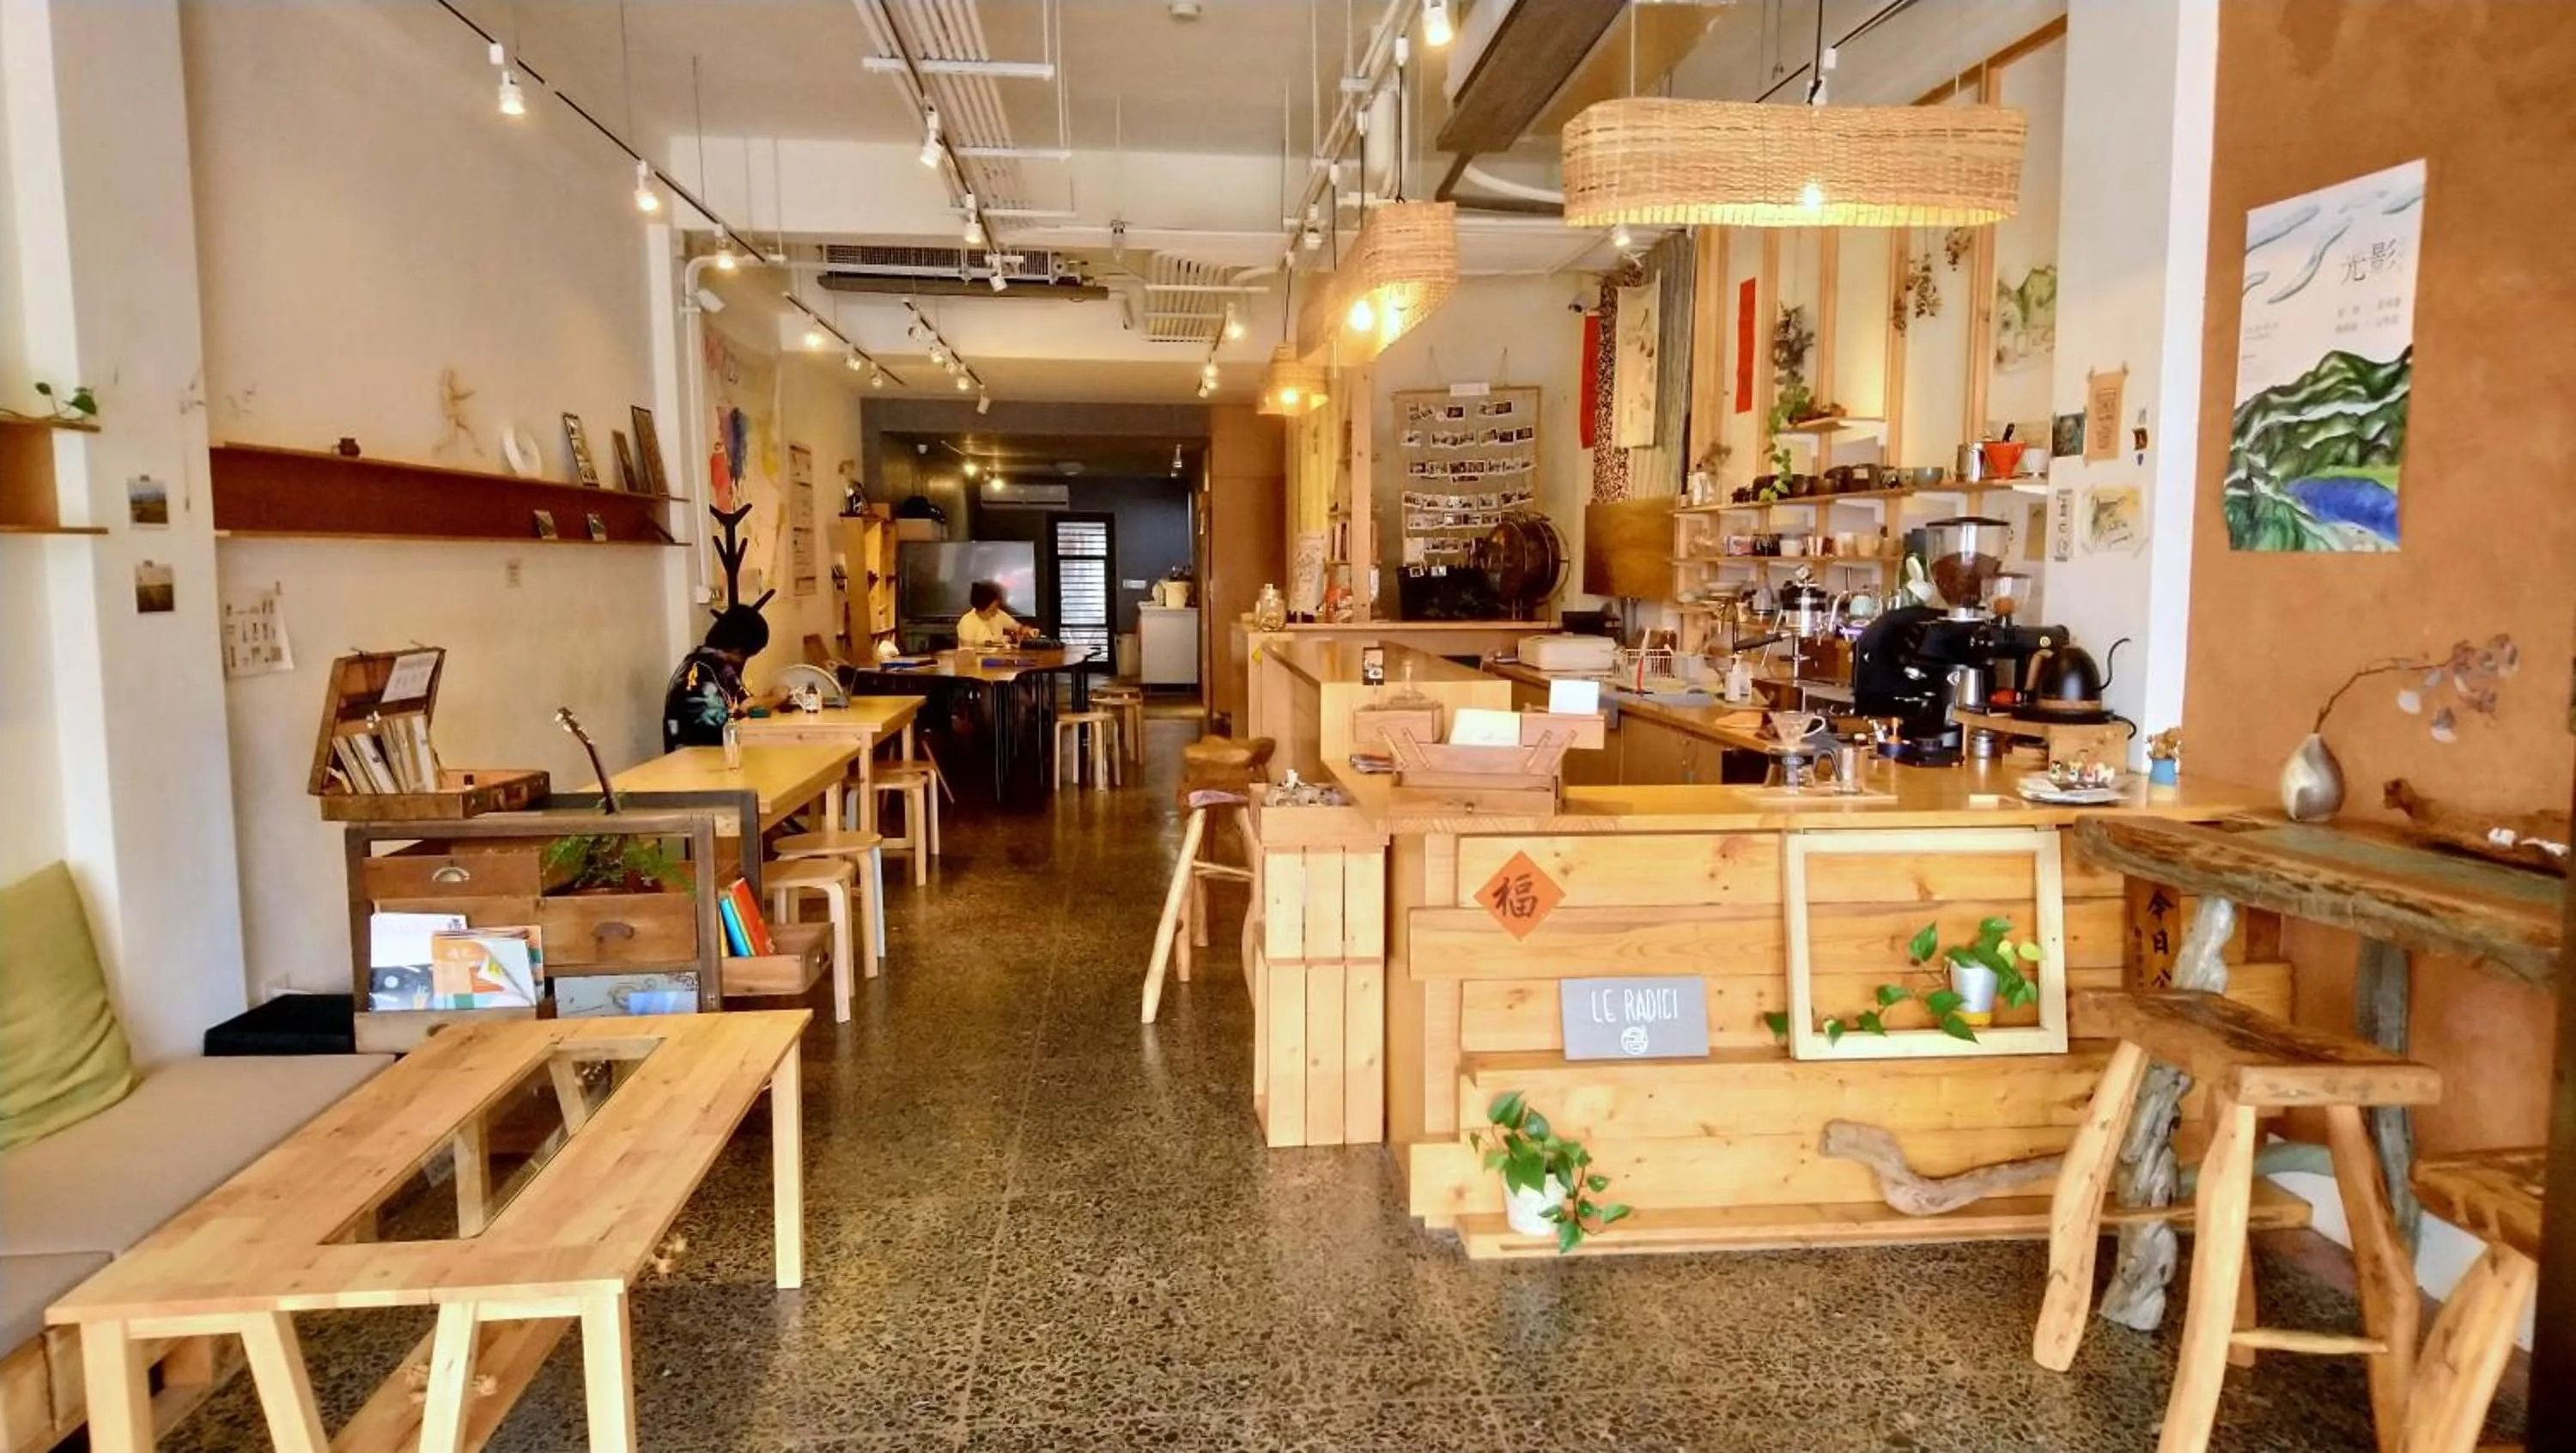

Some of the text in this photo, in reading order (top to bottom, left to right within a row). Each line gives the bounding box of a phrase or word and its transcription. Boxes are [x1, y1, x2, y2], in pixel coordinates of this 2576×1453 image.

[2340, 238, 2402, 286] 光影
[1492, 872, 1539, 919] 福
[1590, 988, 1679, 1024] LE RADICI
